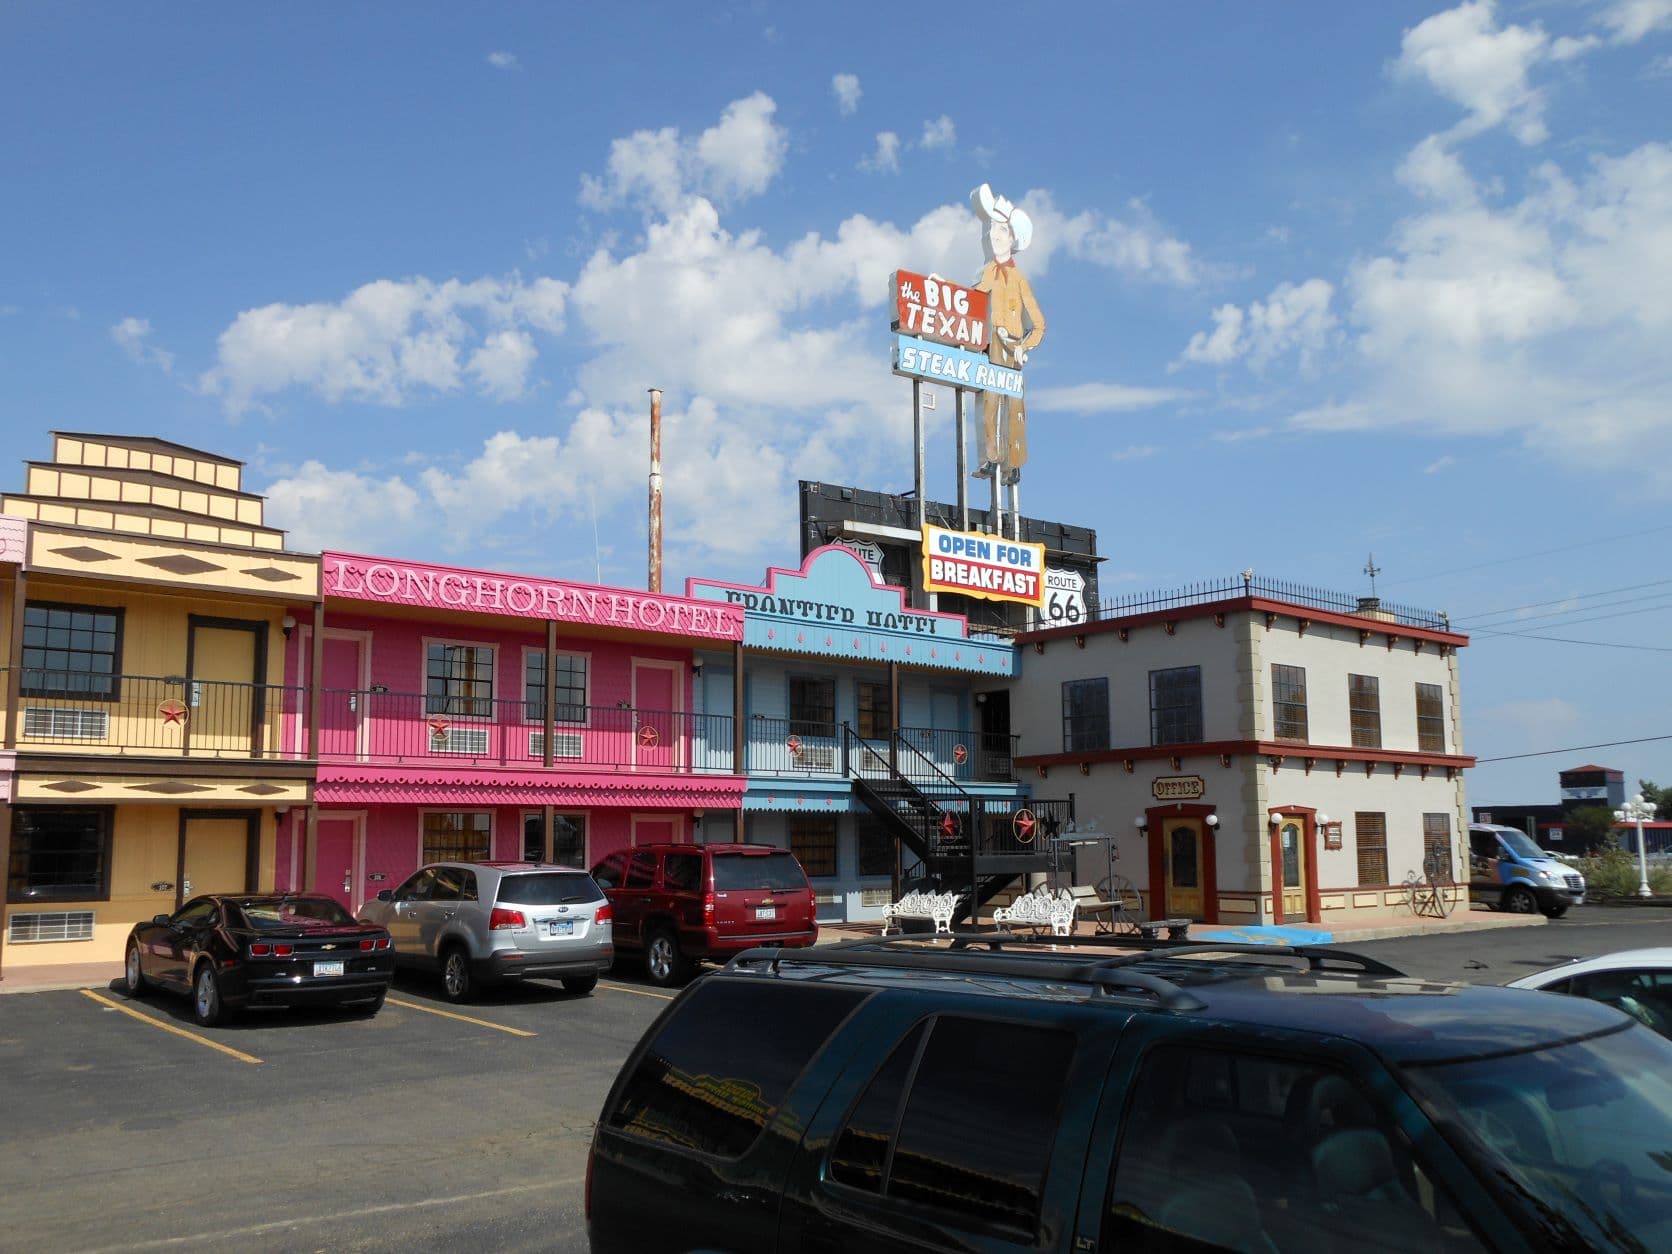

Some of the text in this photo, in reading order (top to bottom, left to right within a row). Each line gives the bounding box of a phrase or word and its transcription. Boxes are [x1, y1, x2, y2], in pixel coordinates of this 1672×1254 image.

[901, 279, 970, 315] the BIG
[907, 302, 983, 345] TEXAN
[902, 347, 1023, 392] STEAK RANCH
[938, 534, 1032, 567] OPEN FOR
[931, 558, 1036, 596] BREAKFAST
[1047, 575, 1078, 589] ROUTE
[331, 560, 734, 636] LONGHORN HOTEL
[1049, 591, 1080, 623] 66
[1156, 781, 1200, 795] OFFICE
